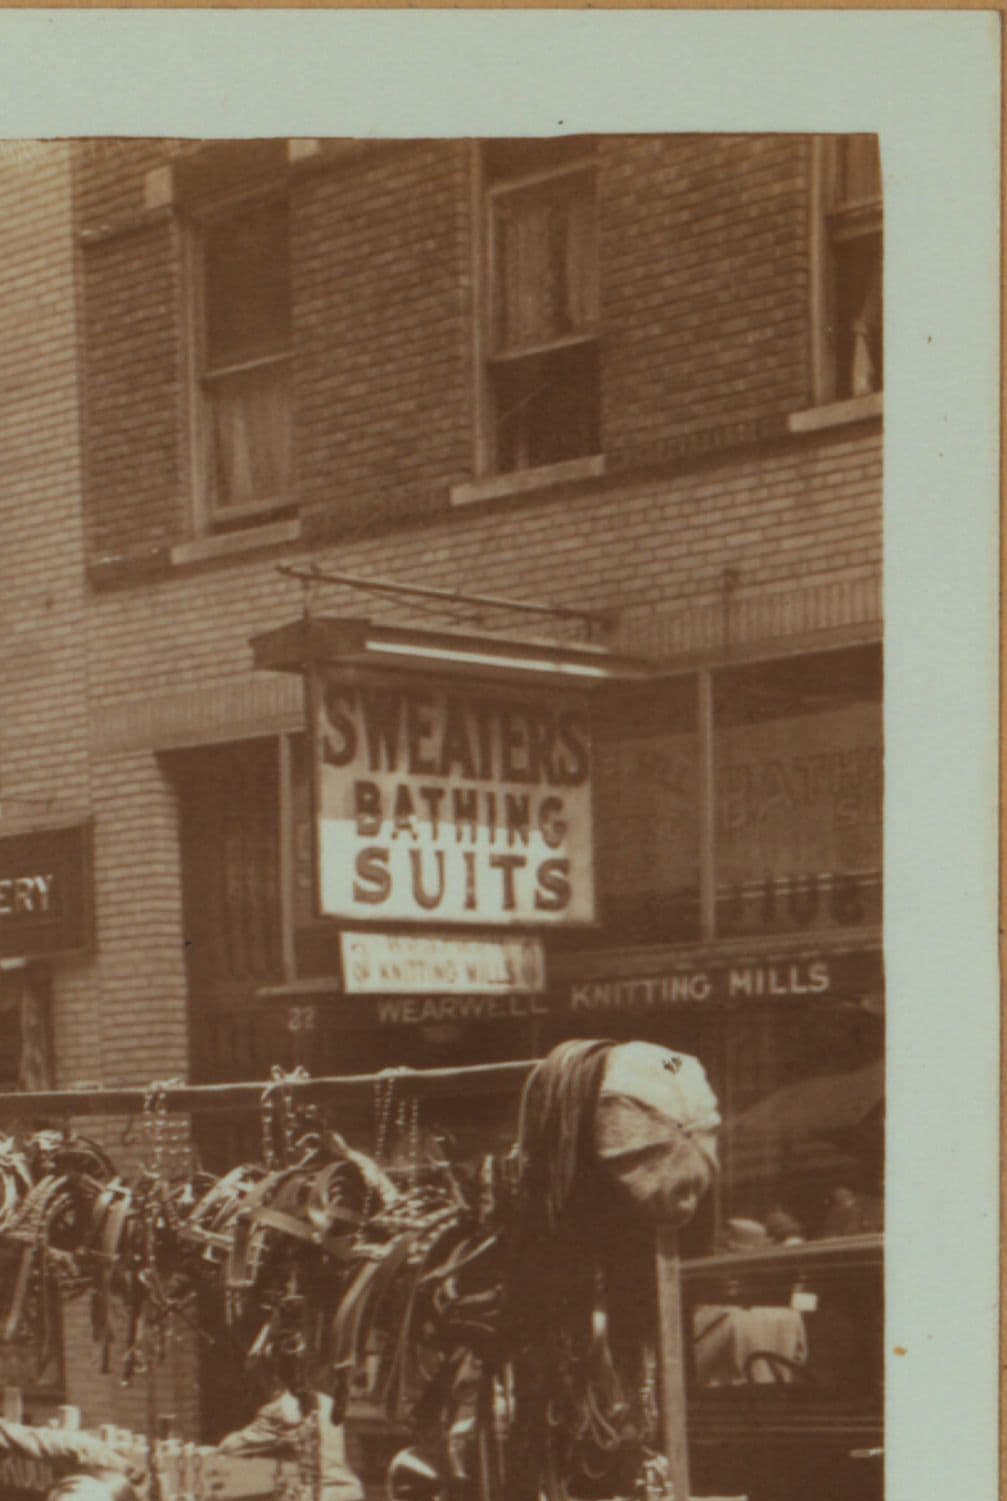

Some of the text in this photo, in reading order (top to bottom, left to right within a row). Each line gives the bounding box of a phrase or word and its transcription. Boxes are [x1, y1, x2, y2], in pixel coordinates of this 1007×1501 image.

[353, 780, 568, 849] BATHING
[352, 847, 573, 911] SUITS
[375, 963, 831, 1024] WEARWELL KNITTING MILLS
